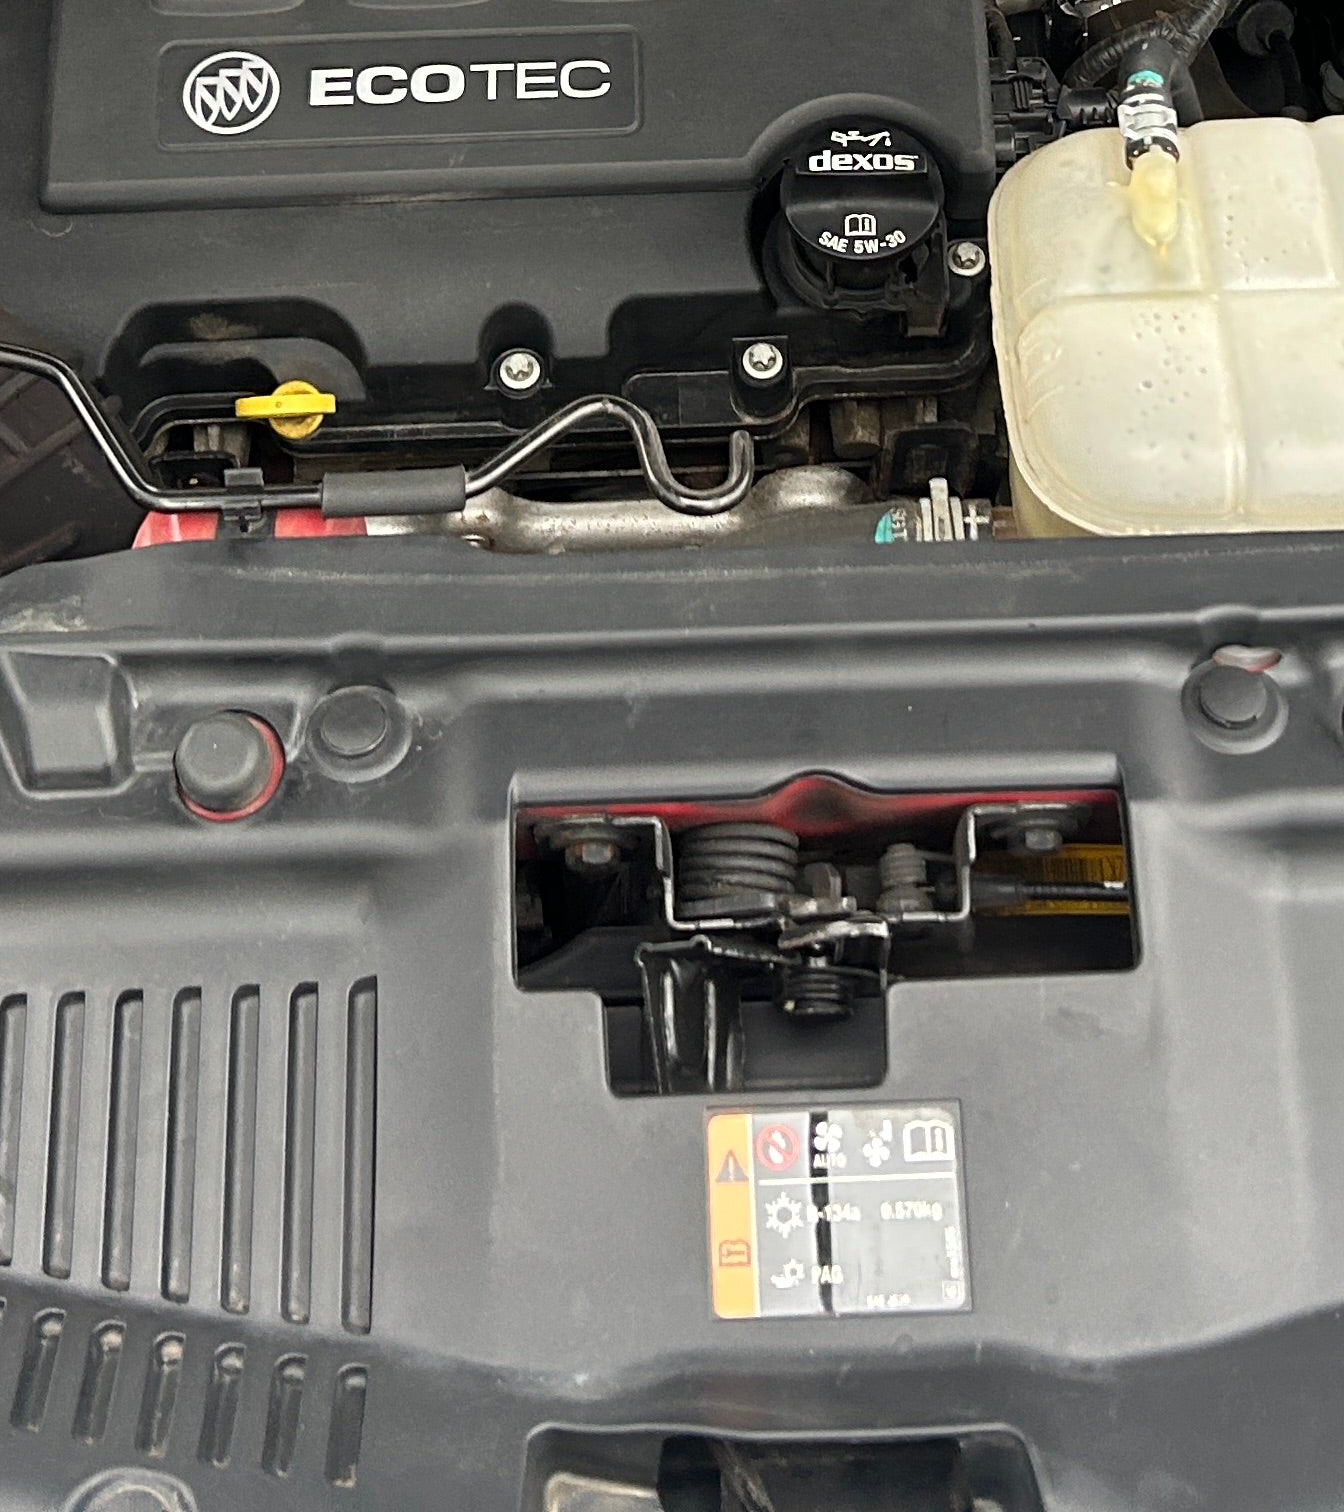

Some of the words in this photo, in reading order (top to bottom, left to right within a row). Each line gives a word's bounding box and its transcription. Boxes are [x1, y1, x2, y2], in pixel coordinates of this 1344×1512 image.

[309, 59, 612, 107] ECOTEC
[808, 149, 915, 172] dexos
[818, 231, 848, 253] SAE
[853, 230, 906, 254] 5W-30
[813, 1153, 847, 1168] AUTO
[810, 1264, 844, 1285] PAG
